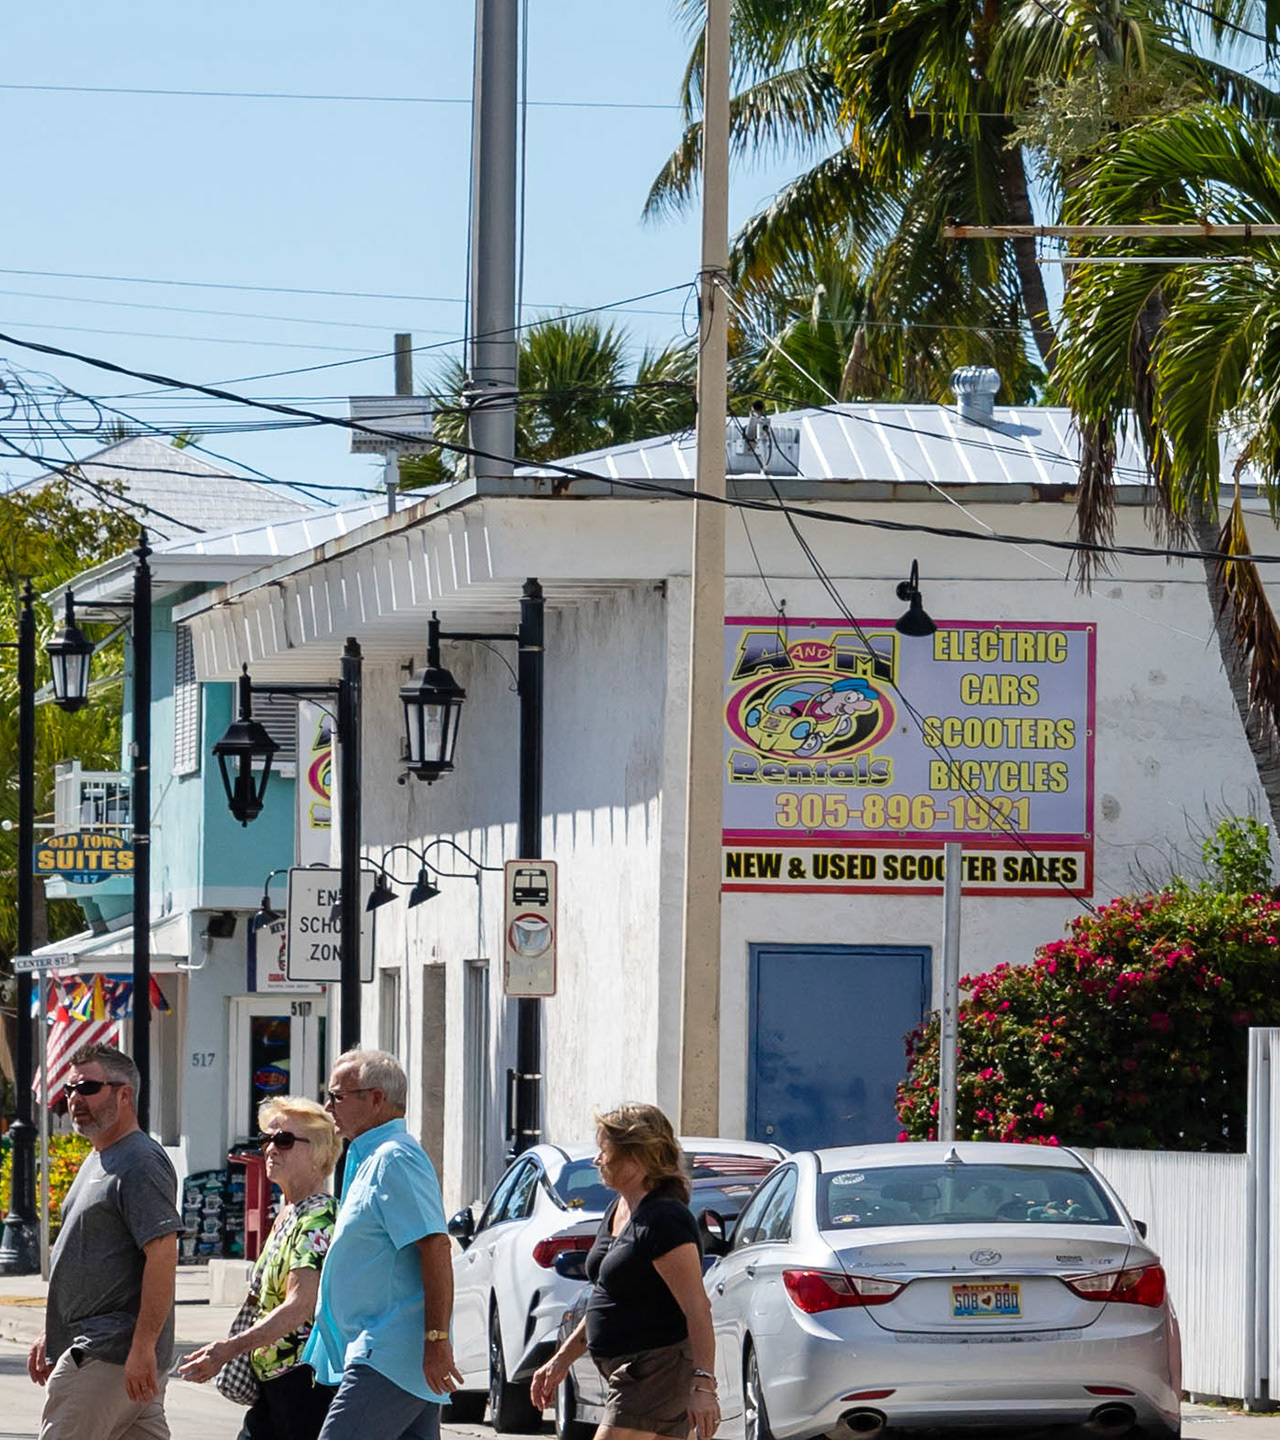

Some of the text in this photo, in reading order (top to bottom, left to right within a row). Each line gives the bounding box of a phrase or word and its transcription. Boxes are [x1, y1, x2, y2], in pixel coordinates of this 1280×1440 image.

[730, 630, 898, 684] A AND M
[932, 630, 1068, 664] ELECTRIC
[960, 673, 1040, 706] CARS
[922, 716, 1076, 750] SCOOTERS
[729, 750, 893, 787] Rentals
[929, 759, 1068, 793] BICYCLES
[775, 792, 1031, 832] 305-896-1921
[48, 834, 124, 849] OLD TOWN
[37, 850, 135, 870] SUITES
[725, 852, 783, 880] NEW
[787, 856, 807, 880] &
[812, 853, 877, 881] USED
[1002, 855, 1078, 884] SALES
[72, 874, 99, 884] 517
[317, 889, 342, 906] EN
[17, 957, 52, 969] CENTER
[310, 943, 342, 961] ZON
[192, 1053, 216, 1068] 517
